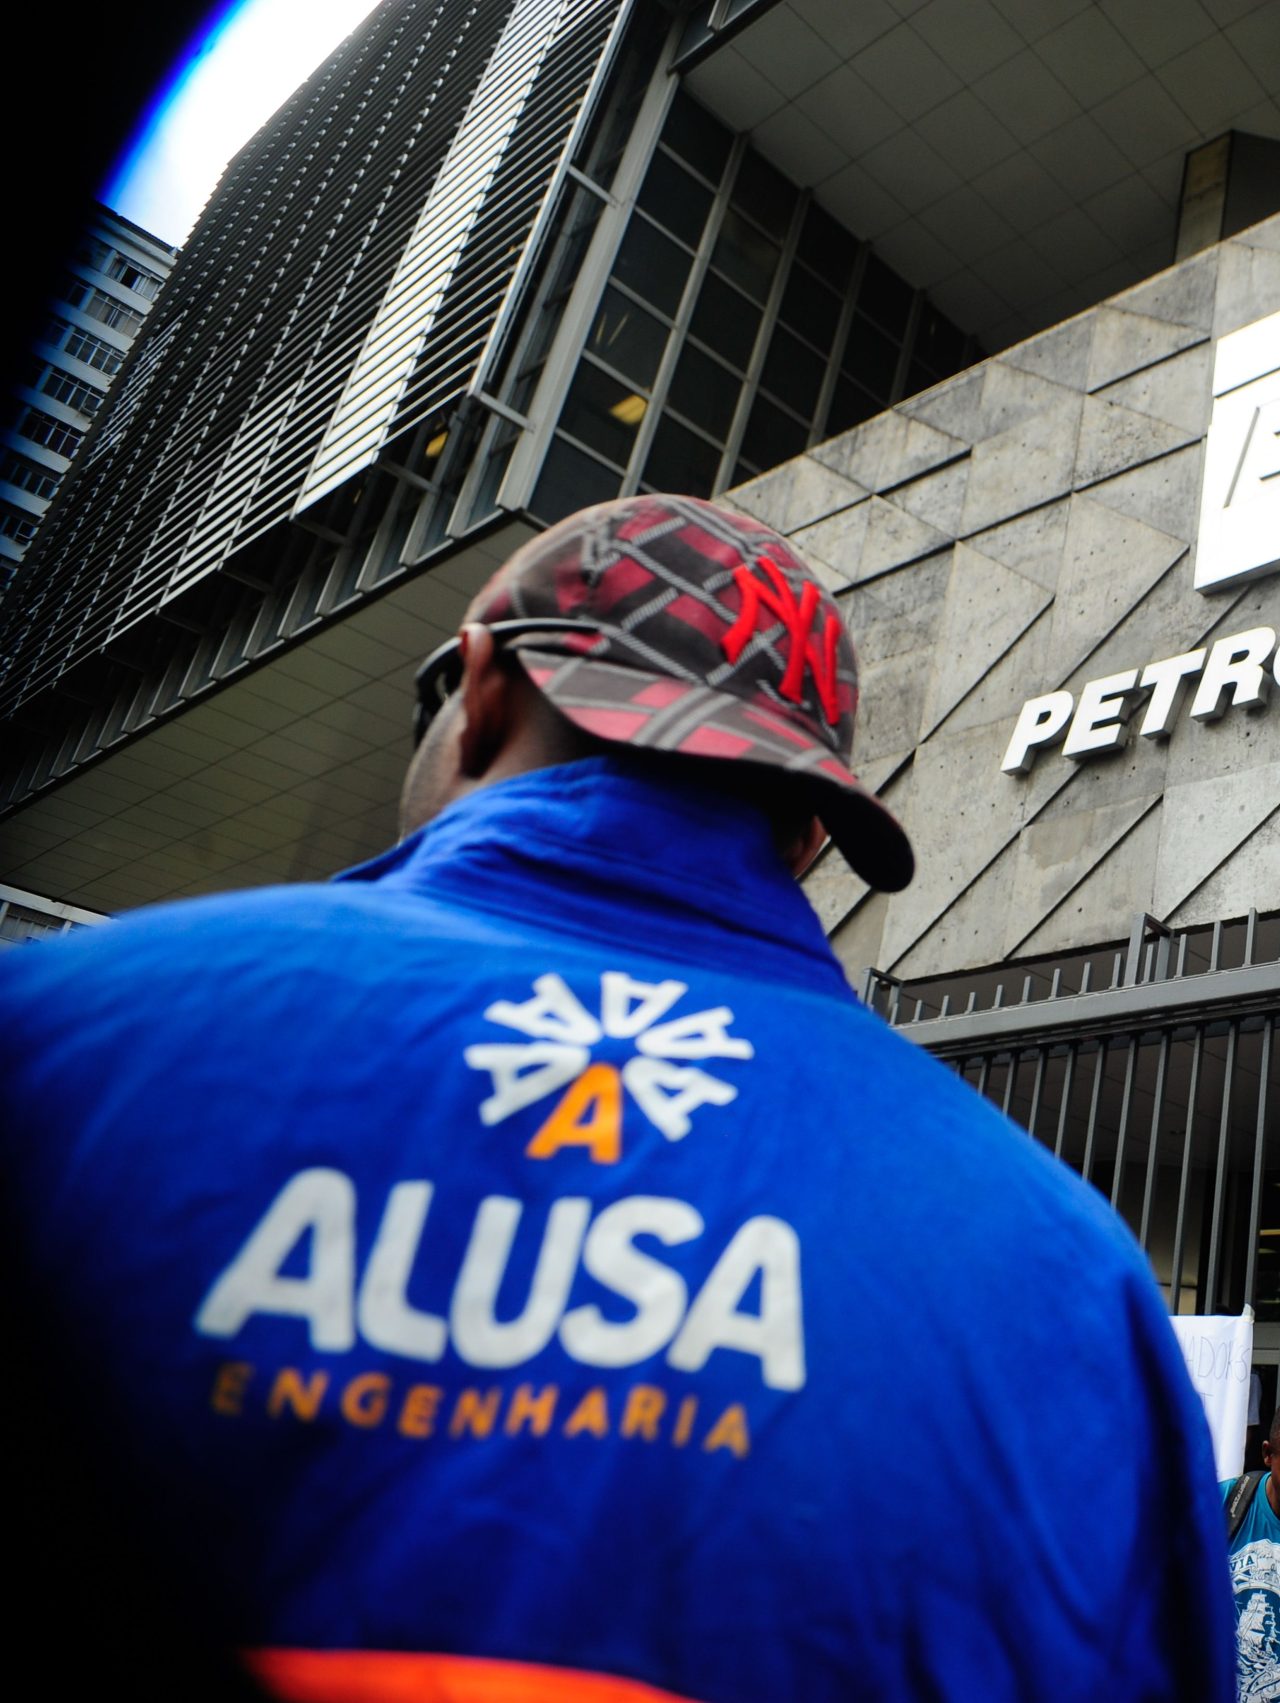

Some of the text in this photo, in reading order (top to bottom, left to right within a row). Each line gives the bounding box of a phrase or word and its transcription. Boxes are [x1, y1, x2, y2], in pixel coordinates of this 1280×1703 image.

[526, 1062, 622, 1163] A
[194, 1167, 806, 1392] ALUSA
[210, 1362, 751, 1458] ENGENHARIA
